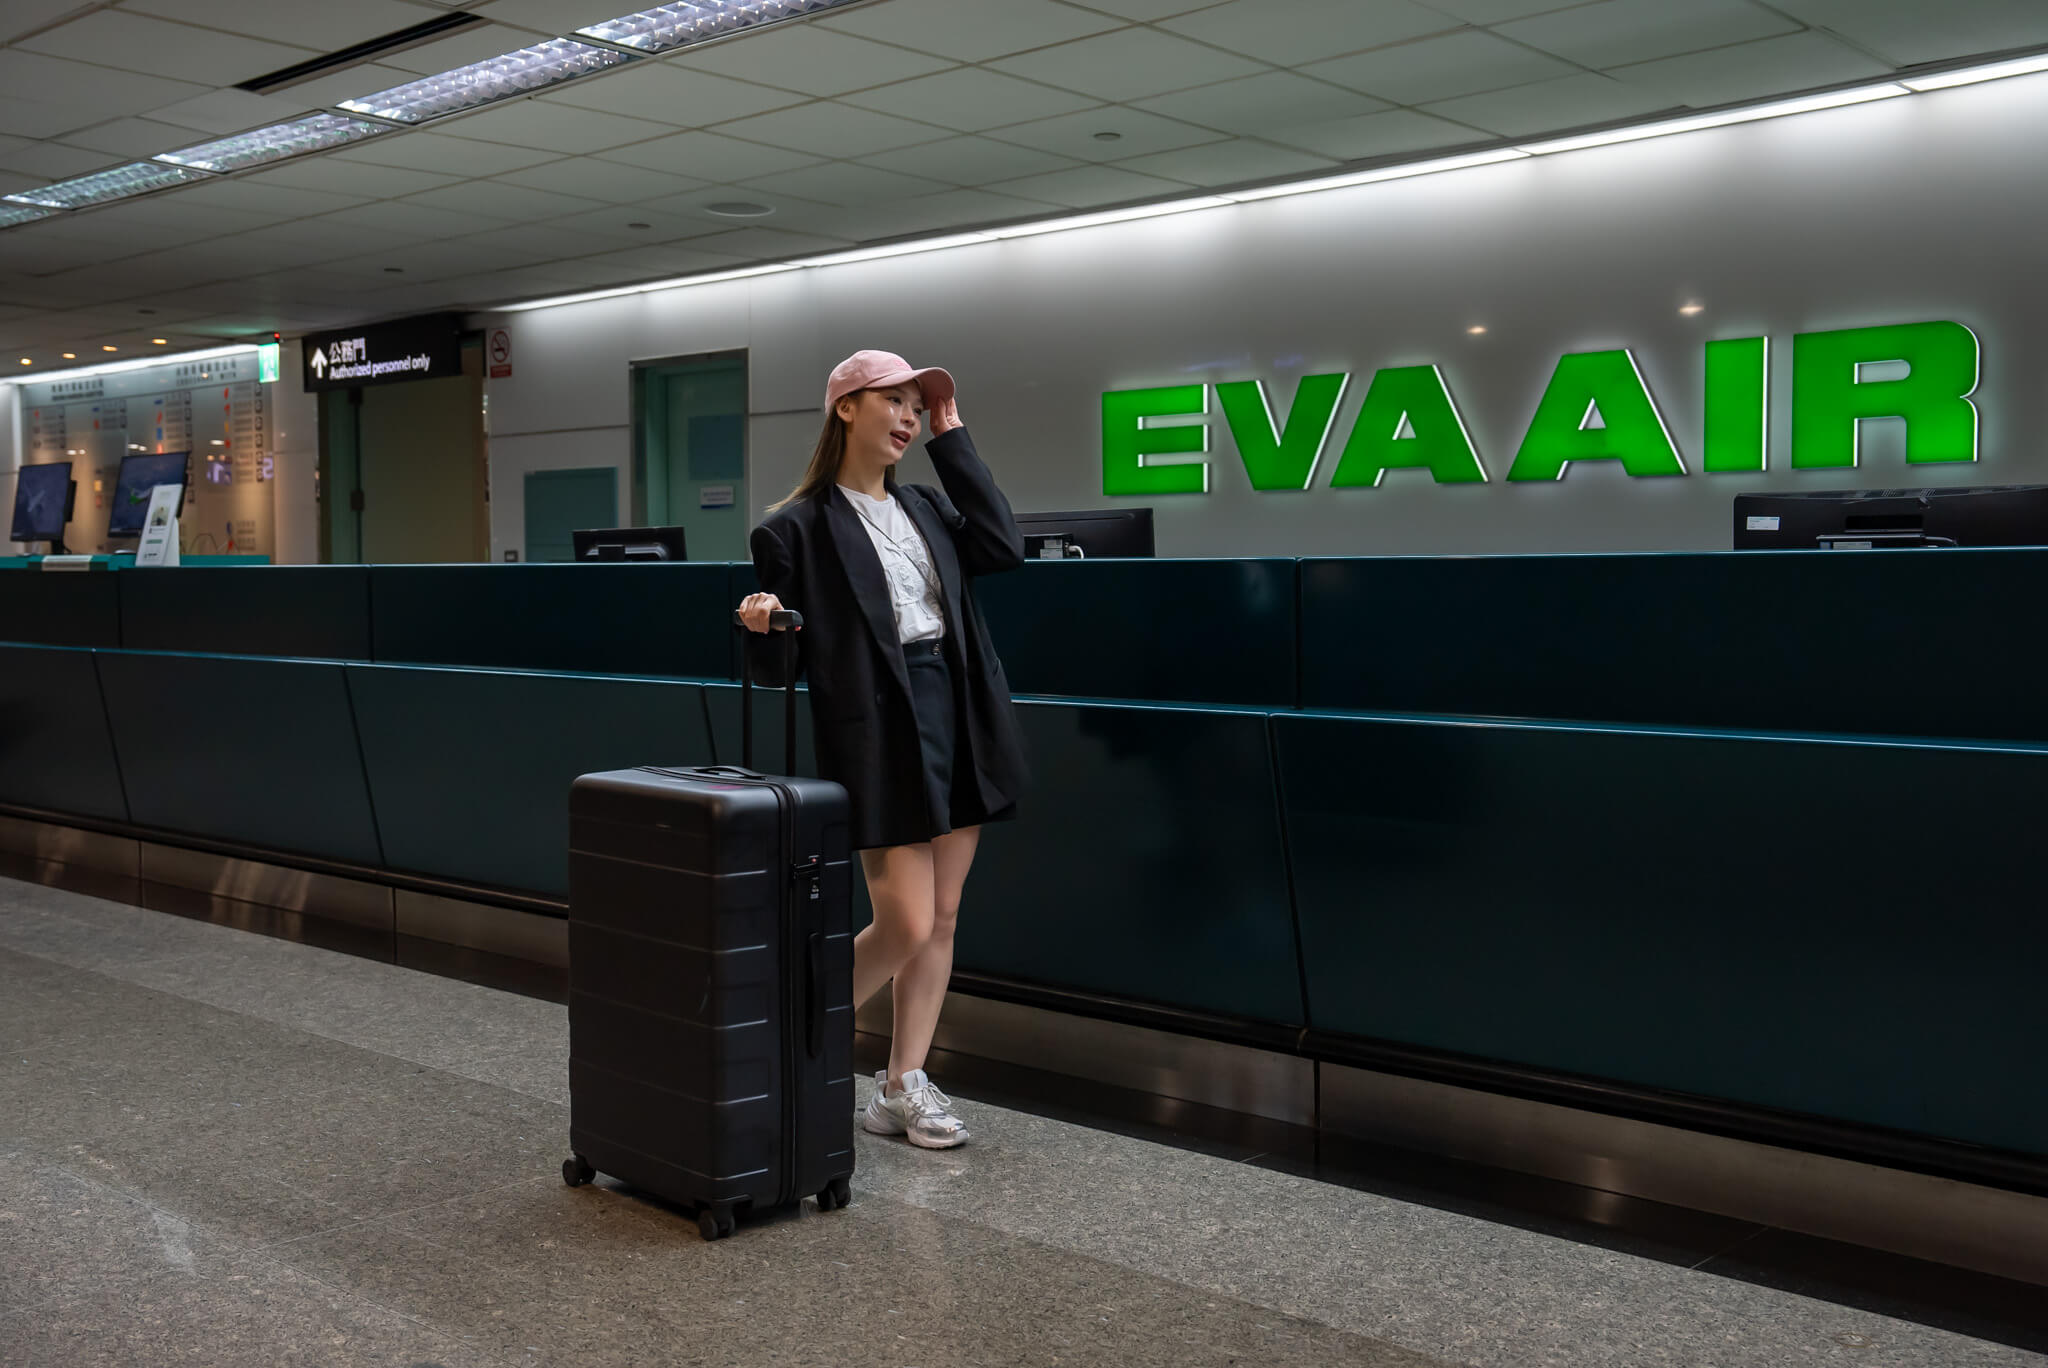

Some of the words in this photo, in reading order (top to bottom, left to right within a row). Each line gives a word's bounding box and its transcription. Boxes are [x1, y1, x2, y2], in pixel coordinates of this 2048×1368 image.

[329, 337, 366, 364] 公務門
[329, 360, 371, 380] Authorized
[372, 355, 411, 378] personnel
[412, 353, 430, 372] only
[1102, 364, 1489, 496] EVA
[1505, 320, 1981, 482] AIR
